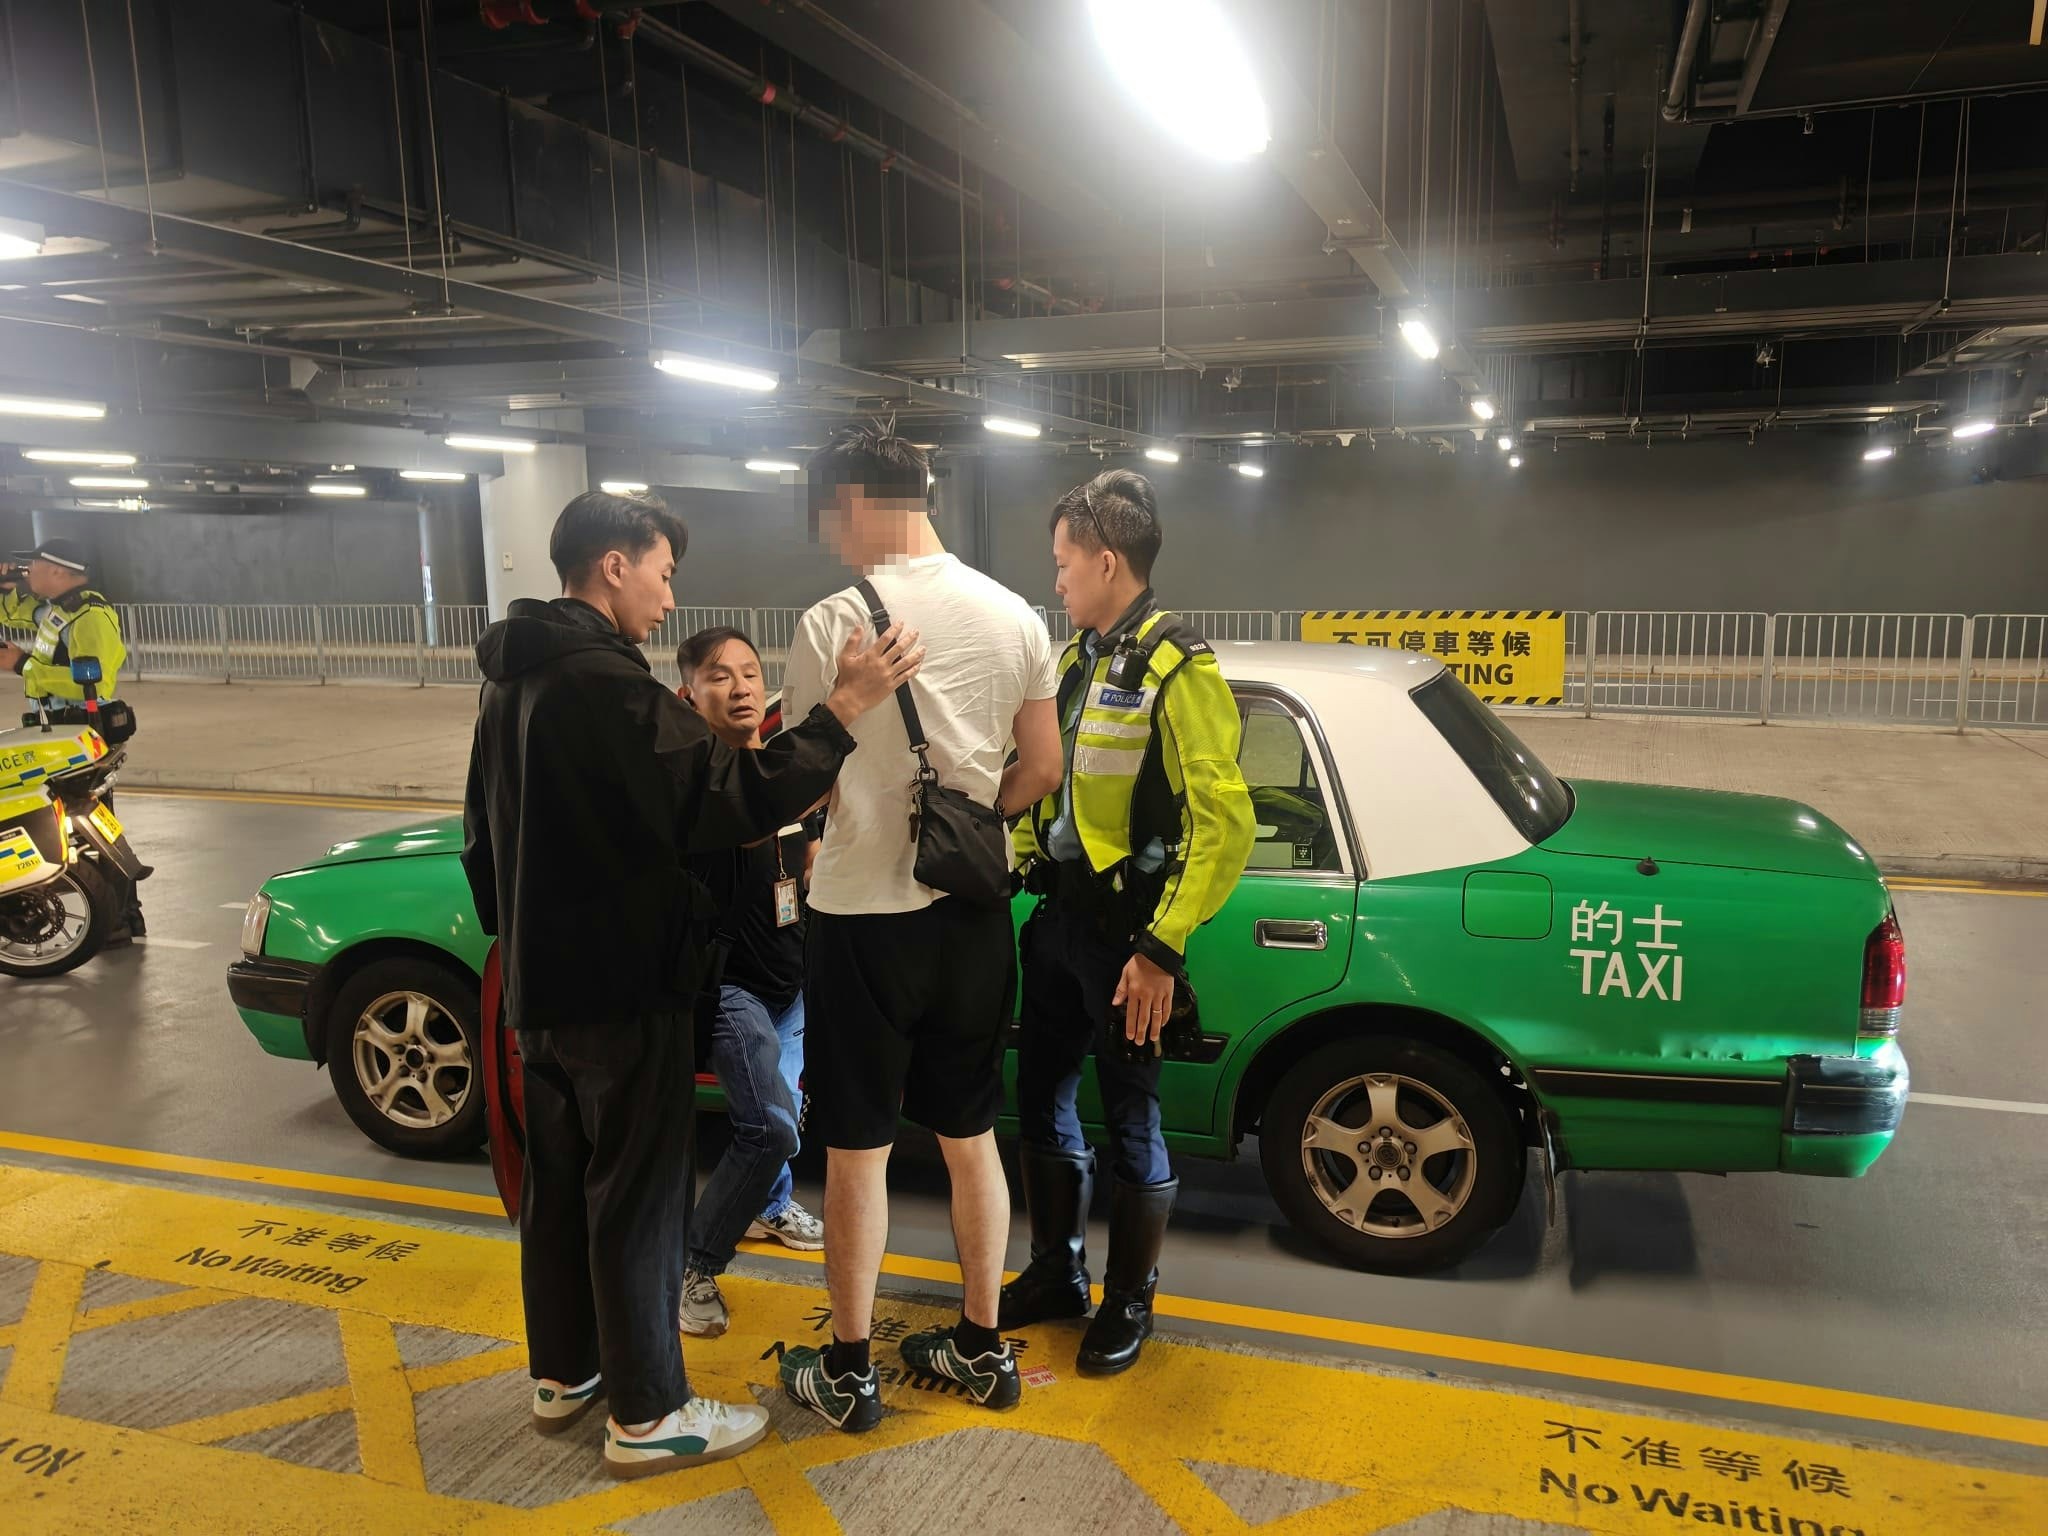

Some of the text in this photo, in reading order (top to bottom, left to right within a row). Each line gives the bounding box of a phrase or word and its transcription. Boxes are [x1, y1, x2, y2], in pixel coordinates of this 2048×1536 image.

[1445, 663, 1514, 686] TING
[1571, 899, 1683, 950] 的士
[1570, 948, 1683, 1001] TAXI
[239, 1219, 421, 1263] 不准等候
[175, 1247, 369, 1294] No Waiting
[1543, 1419, 1853, 1499] 不准等候
[1538, 1466, 1619, 1505] No
